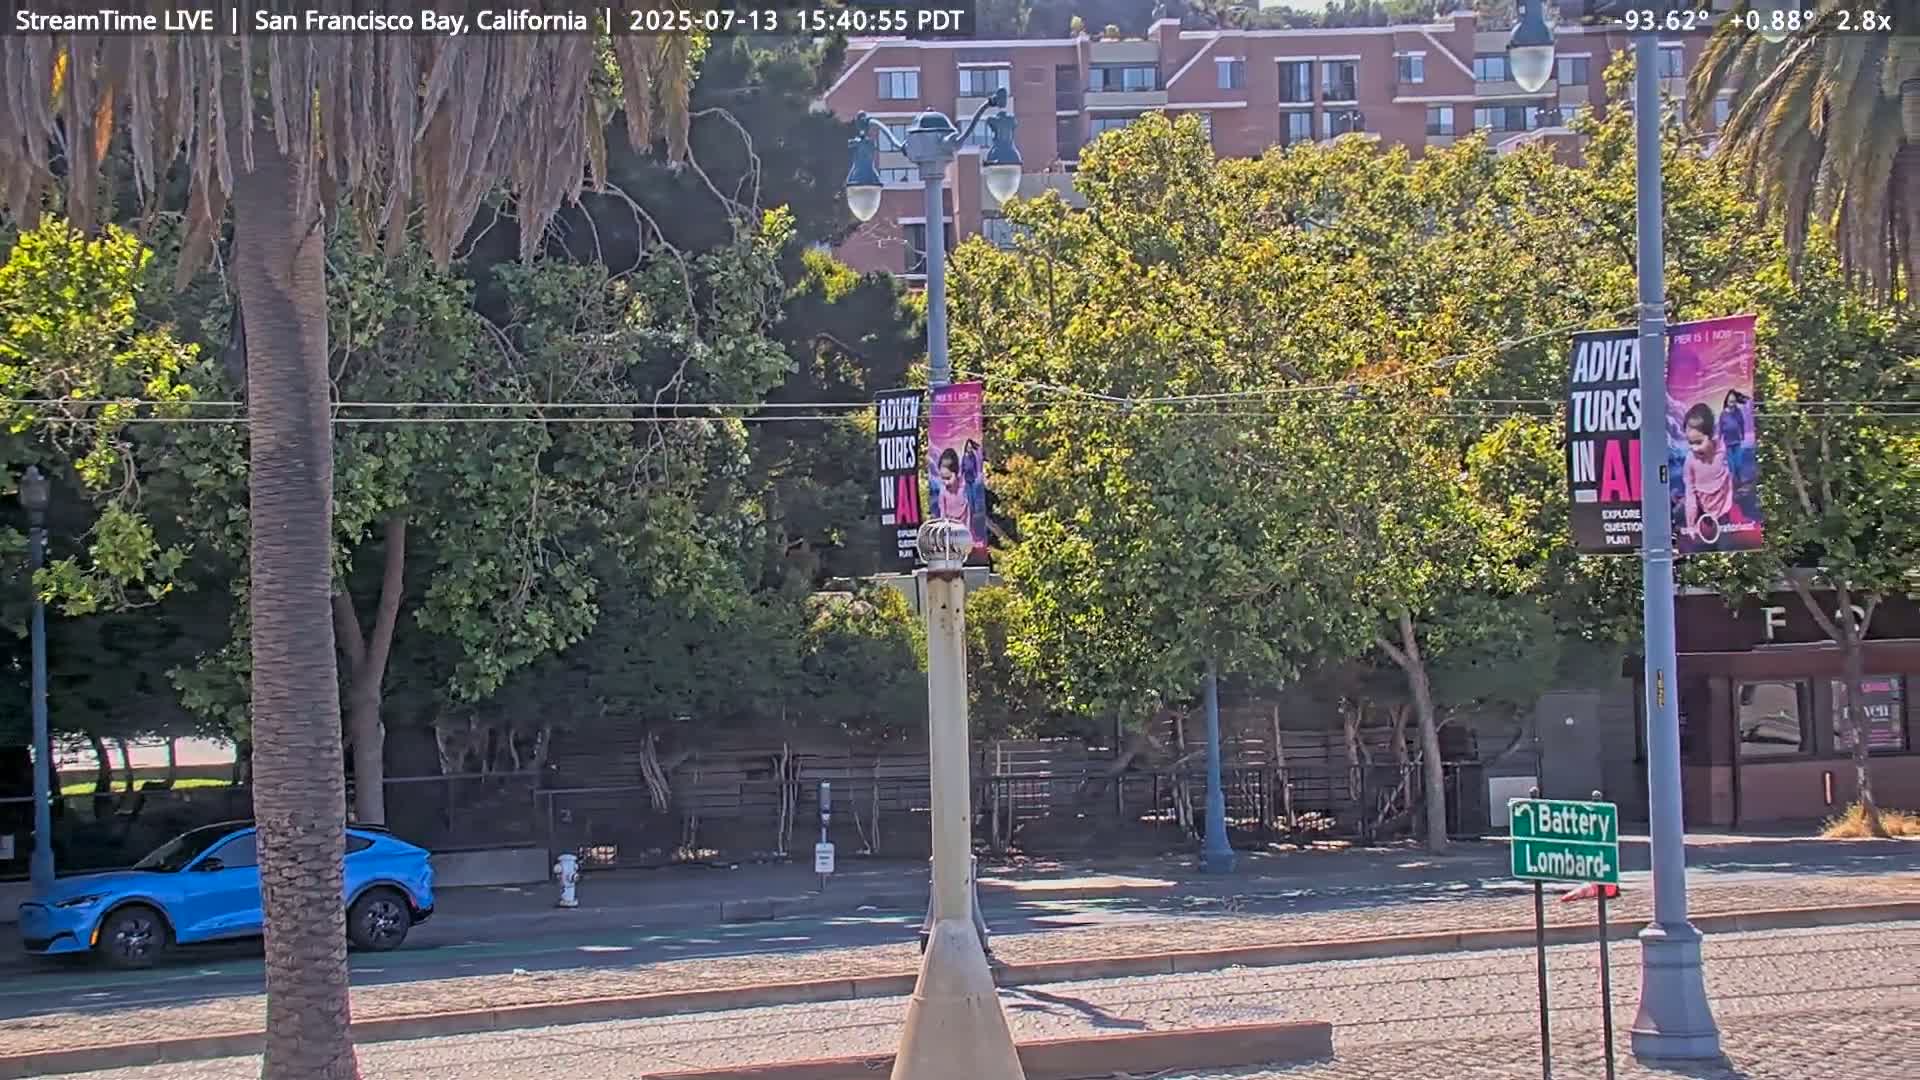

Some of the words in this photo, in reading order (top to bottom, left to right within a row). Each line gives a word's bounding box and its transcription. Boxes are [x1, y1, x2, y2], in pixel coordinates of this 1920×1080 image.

[1572, 339, 1641, 383] ADVEN
[878, 395, 920, 433] ADVEN
[1571, 388, 1641, 433] TURES
[878, 435, 916, 472] TURES
[1572, 439, 1596, 483] IN
[1600, 438, 1641, 503] AI
[880, 474, 896, 510] IN
[895, 473, 920, 525] AI
[1538, 803, 1610, 842] Battery
[1525, 842, 1605, 879] Lombard
